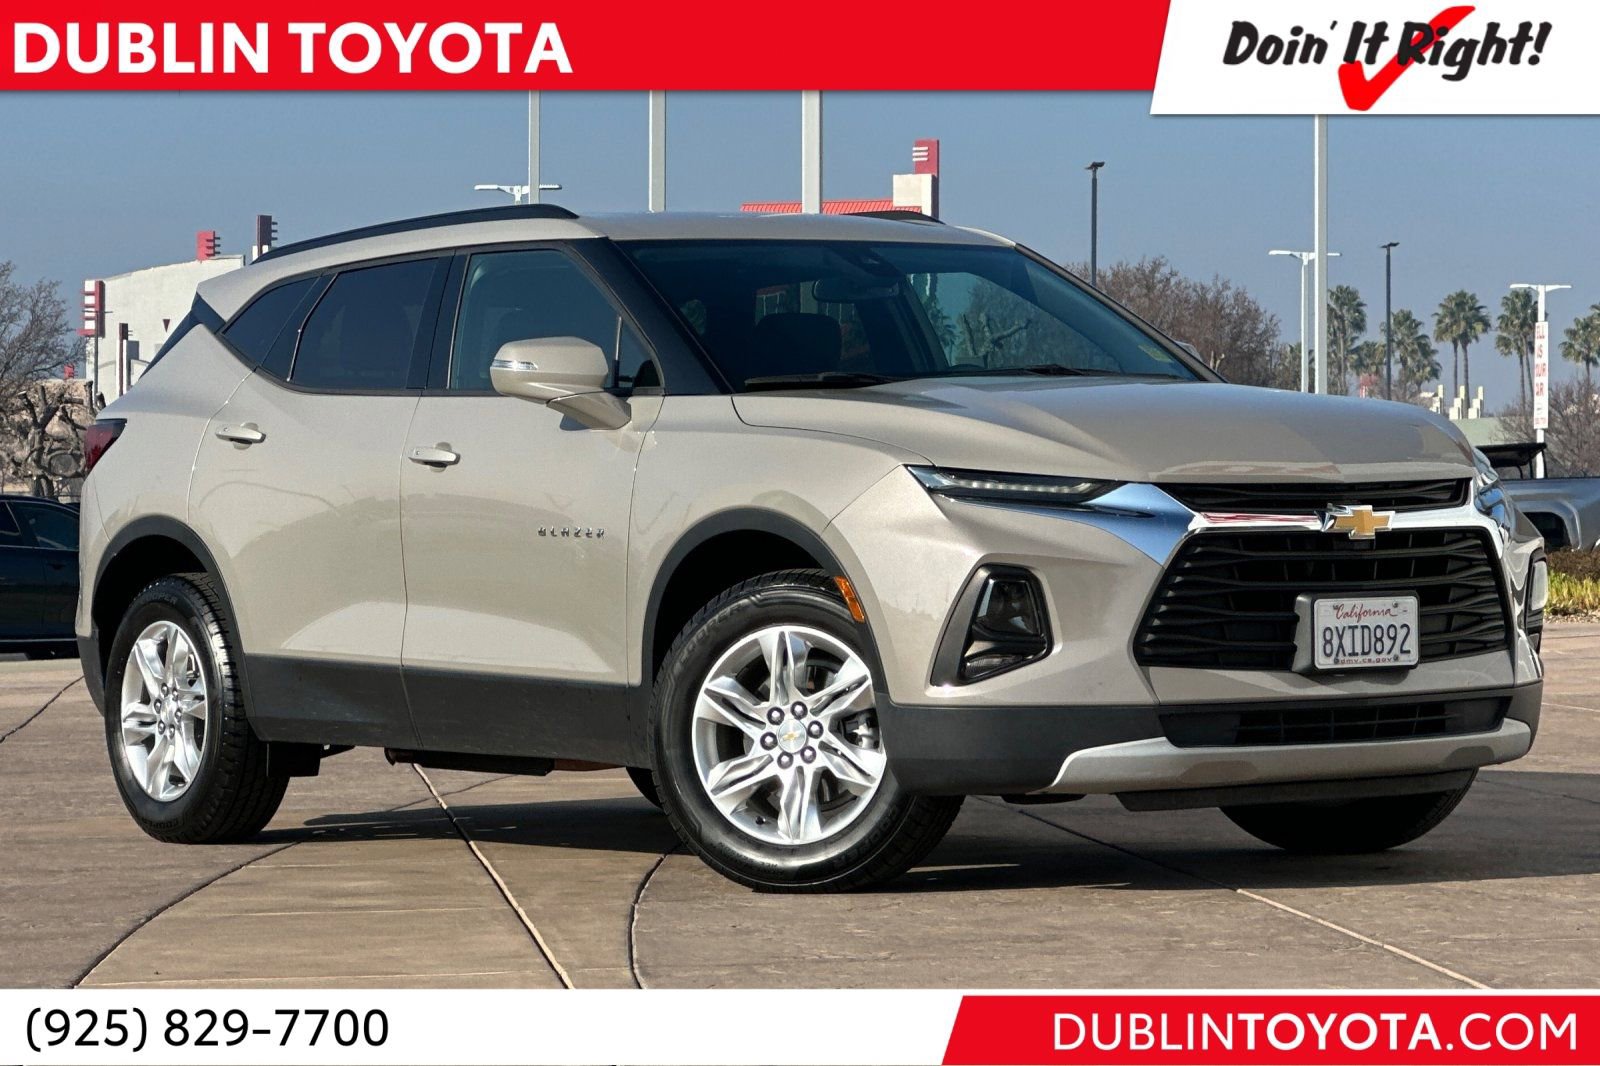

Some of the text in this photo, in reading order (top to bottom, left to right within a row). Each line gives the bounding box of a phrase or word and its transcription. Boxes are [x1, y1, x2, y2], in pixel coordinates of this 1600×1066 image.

[537, 525, 605, 539] BLAZER
[1335, 603, 1397, 623] California
[1323, 623, 1411, 658] 8XID892
